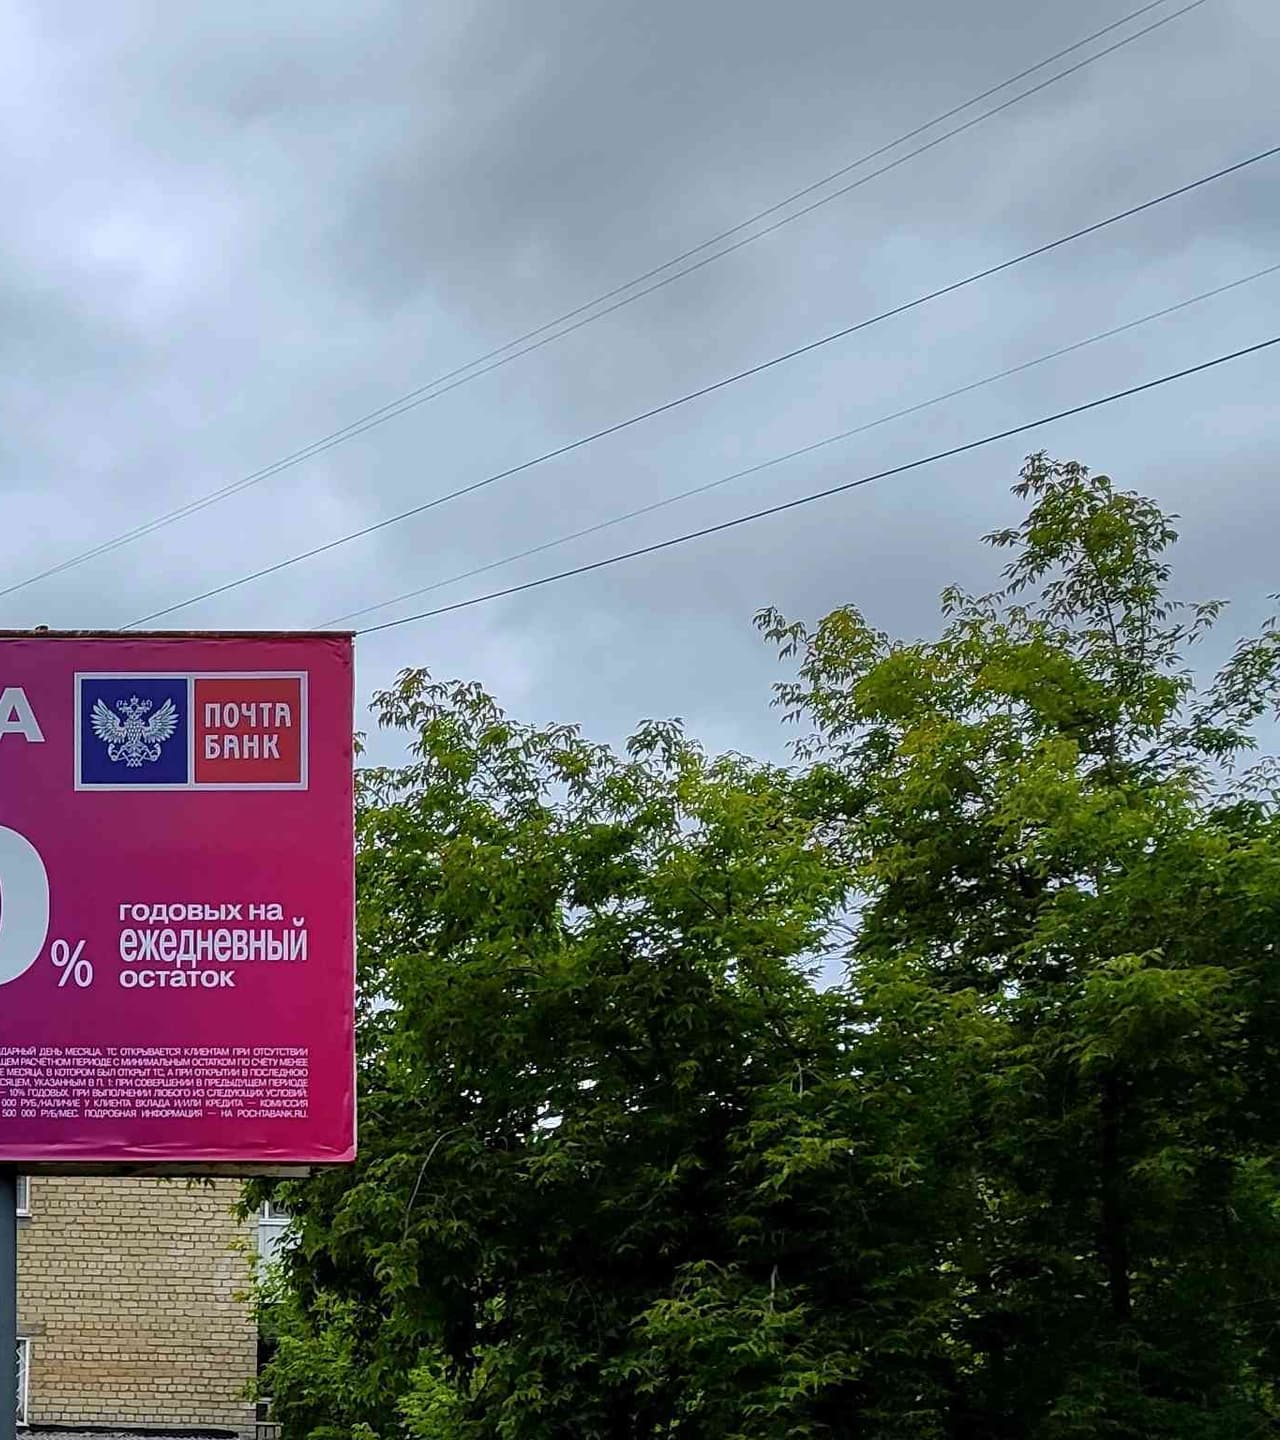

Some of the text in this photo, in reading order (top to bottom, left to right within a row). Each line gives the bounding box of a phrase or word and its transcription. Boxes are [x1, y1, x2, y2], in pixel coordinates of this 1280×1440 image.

[205, 703, 291, 728] ПОЧТА
[205, 734, 280, 759] БАНК
[119, 903, 284, 924] годовых на
[119, 917, 308, 968] ежедневный
[51, 939, 93, 987] %
[119, 970, 235, 988] остаток
[38, 1047, 62, 1056] ДЕНЬ
[107, 1047, 116, 1056] ТС
[120, 1047, 180, 1056] ОТКРЫВАЕТСЯ
[183, 1047, 229, 1056] КЛИЕНТАМ
[232, 1047, 250, 1056] ПРИ
[252, 1047, 308, 1057] ОТСУТСТВИИ
[1, 1098, 16, 1107] 000
[84, 1098, 89, 1107] У
[93, 1098, 131, 1107] КЛИЕНТА
[135, 1098, 170, 1107] ВКЛАДА
[204, 1098, 243, 1107] КРЕДИТА
[259, 1098, 308, 1107] КОМИССИЯ
[1, 1109, 16, 1118] 500
[20, 1109, 36, 1118] 000
[84, 1109, 136, 1118] ПОДРОБНАЯ
[141, 1109, 202, 1118] ИНФОРМАЦИЯ
[220, 1109, 232, 1118] НА
